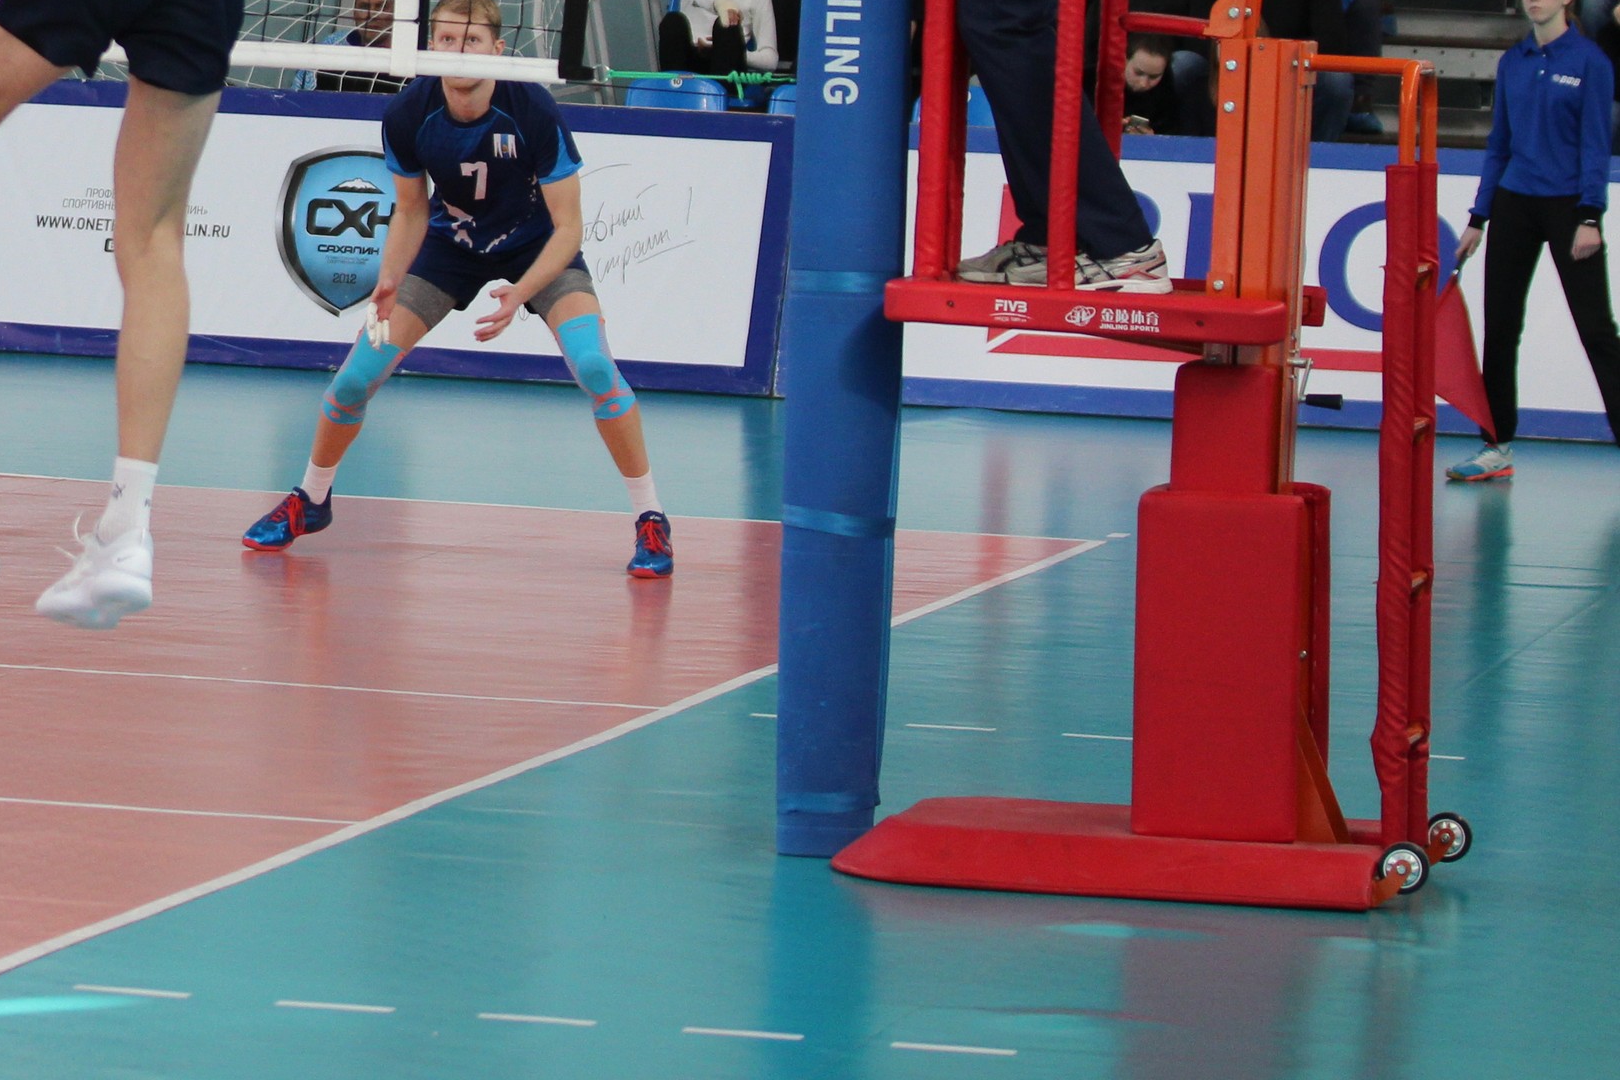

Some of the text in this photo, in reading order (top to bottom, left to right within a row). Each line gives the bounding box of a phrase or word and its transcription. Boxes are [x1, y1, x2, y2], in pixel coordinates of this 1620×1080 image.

[460, 161, 488, 200] 7
[332, 273, 357, 285] 2012
[995, 299, 1028, 313] FIVB
